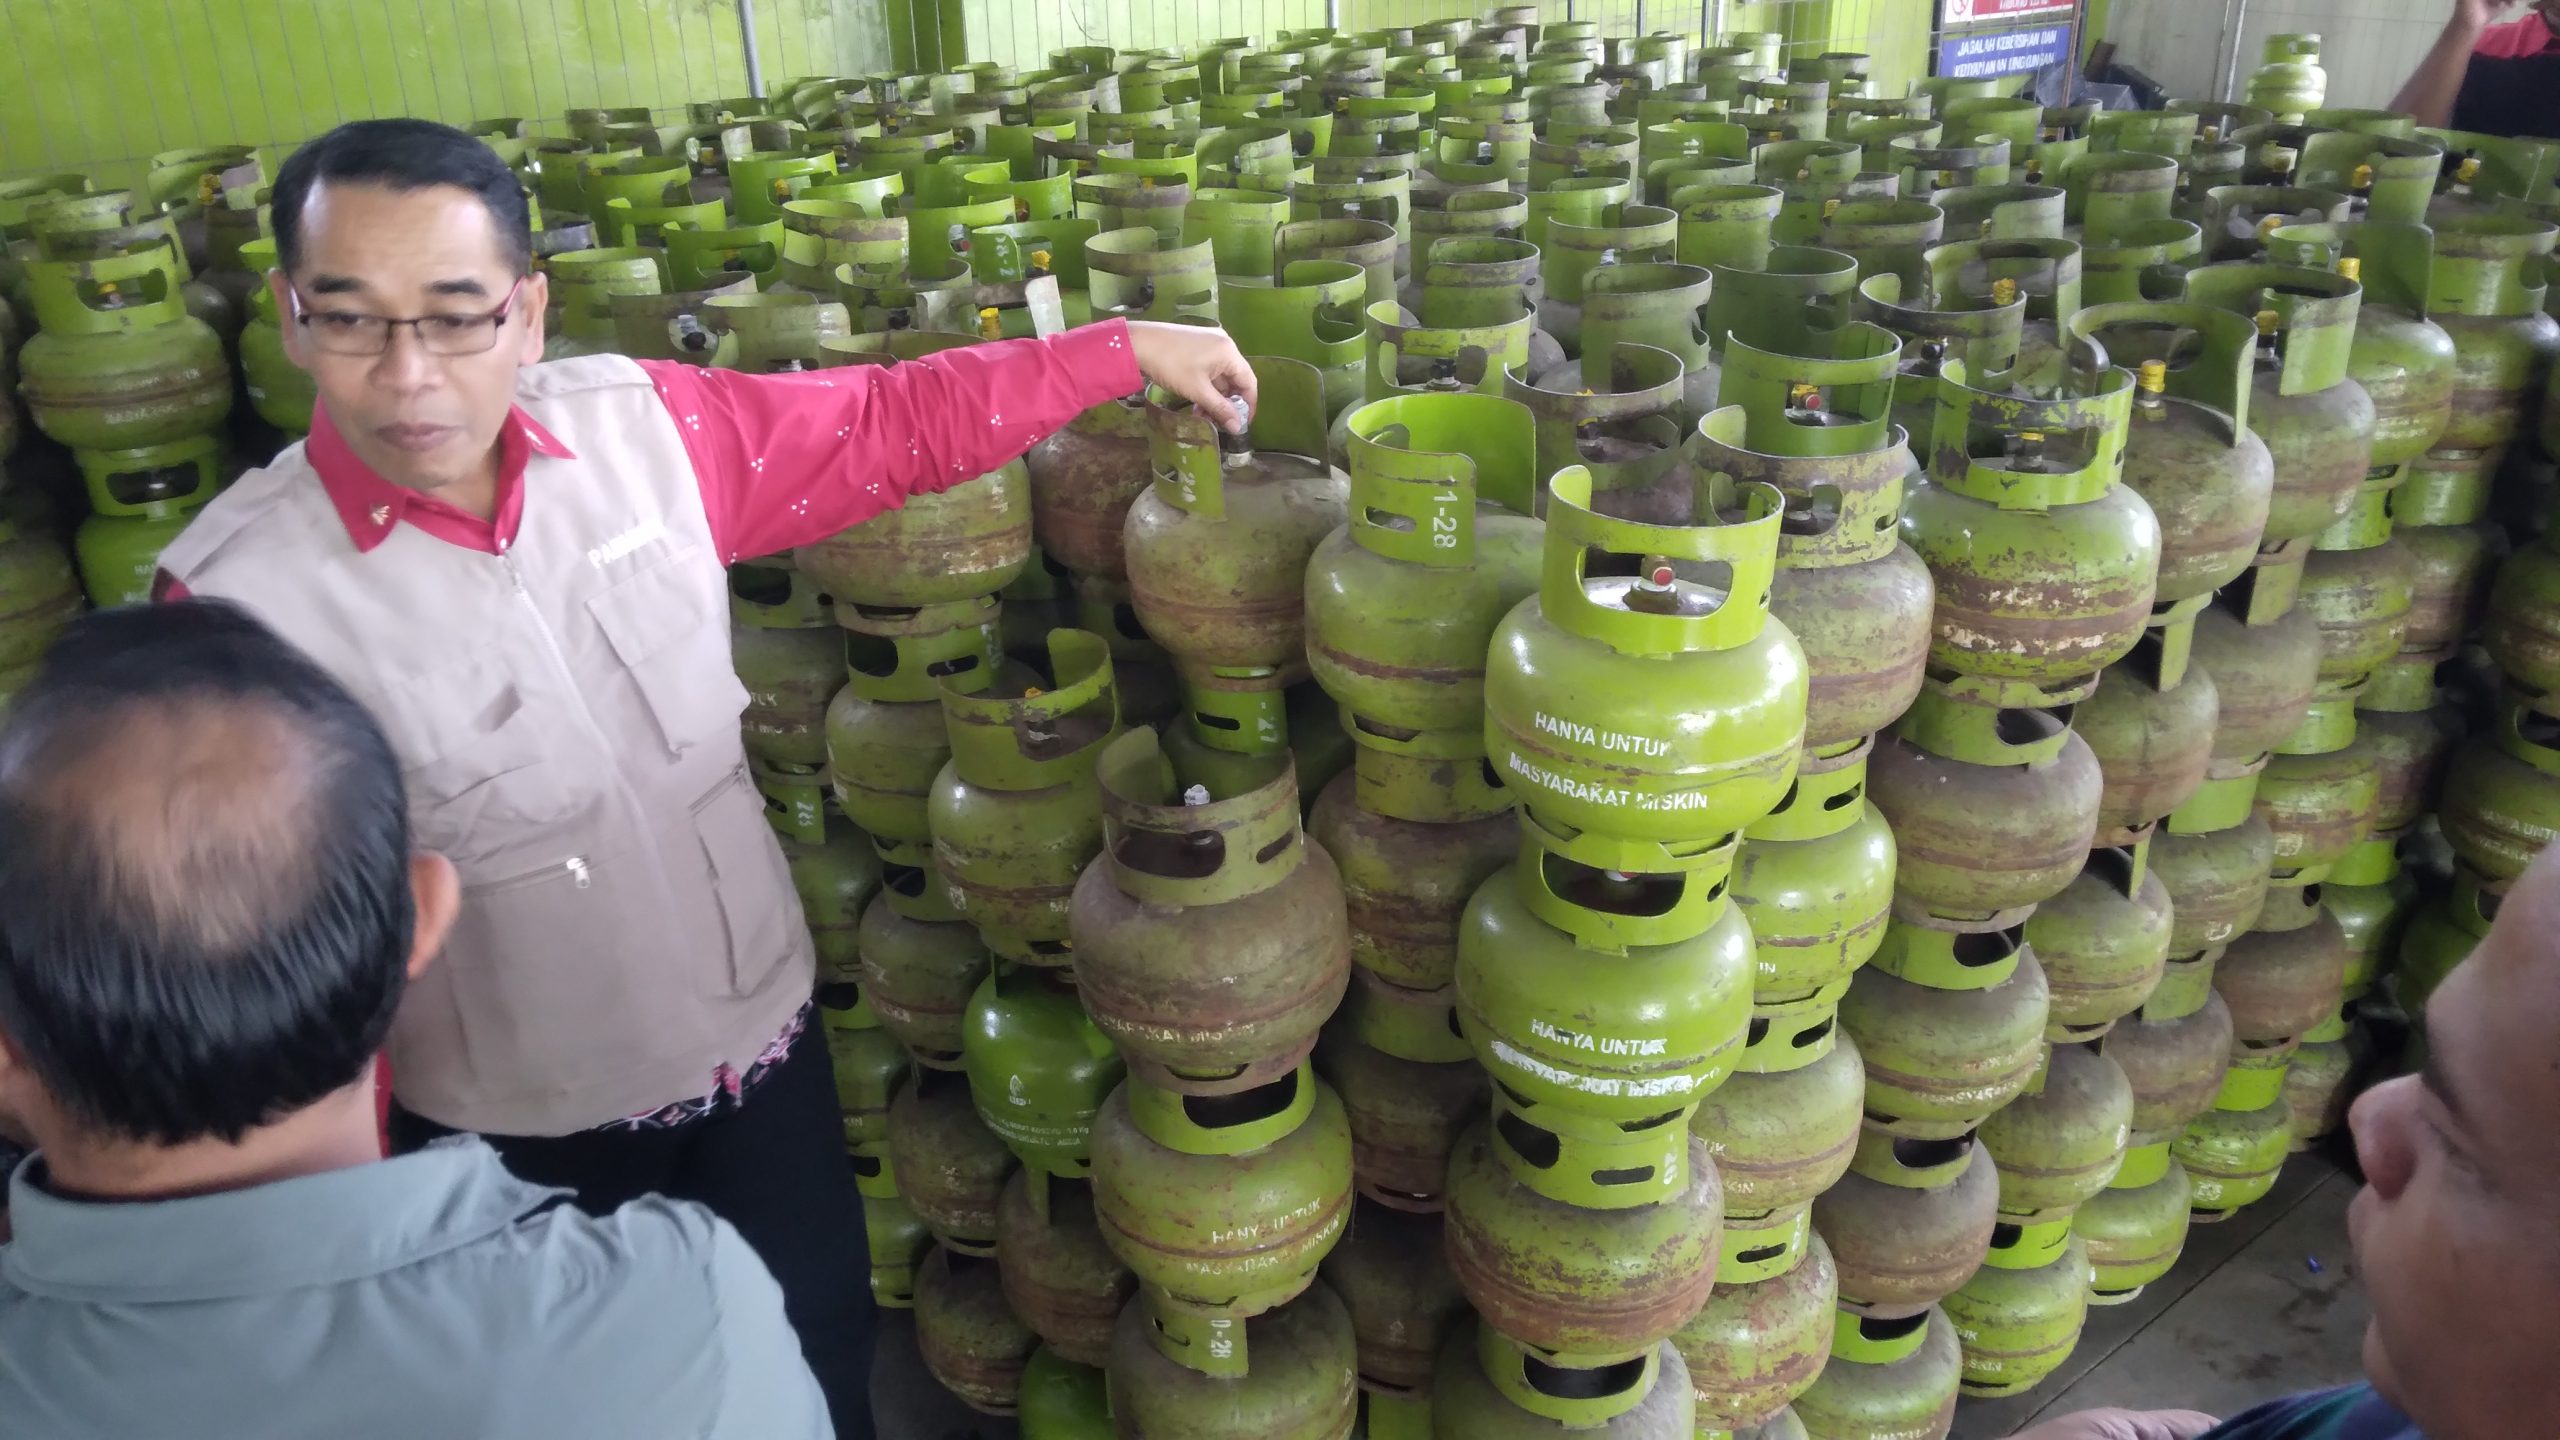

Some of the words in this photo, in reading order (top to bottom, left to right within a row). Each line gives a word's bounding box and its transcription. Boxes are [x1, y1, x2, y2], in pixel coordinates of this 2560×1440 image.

[1535, 711, 1596, 746] HANYA
[1509, 751, 1631, 807] MASYARAKAT
[1531, 1018, 1595, 1052] HANYA
